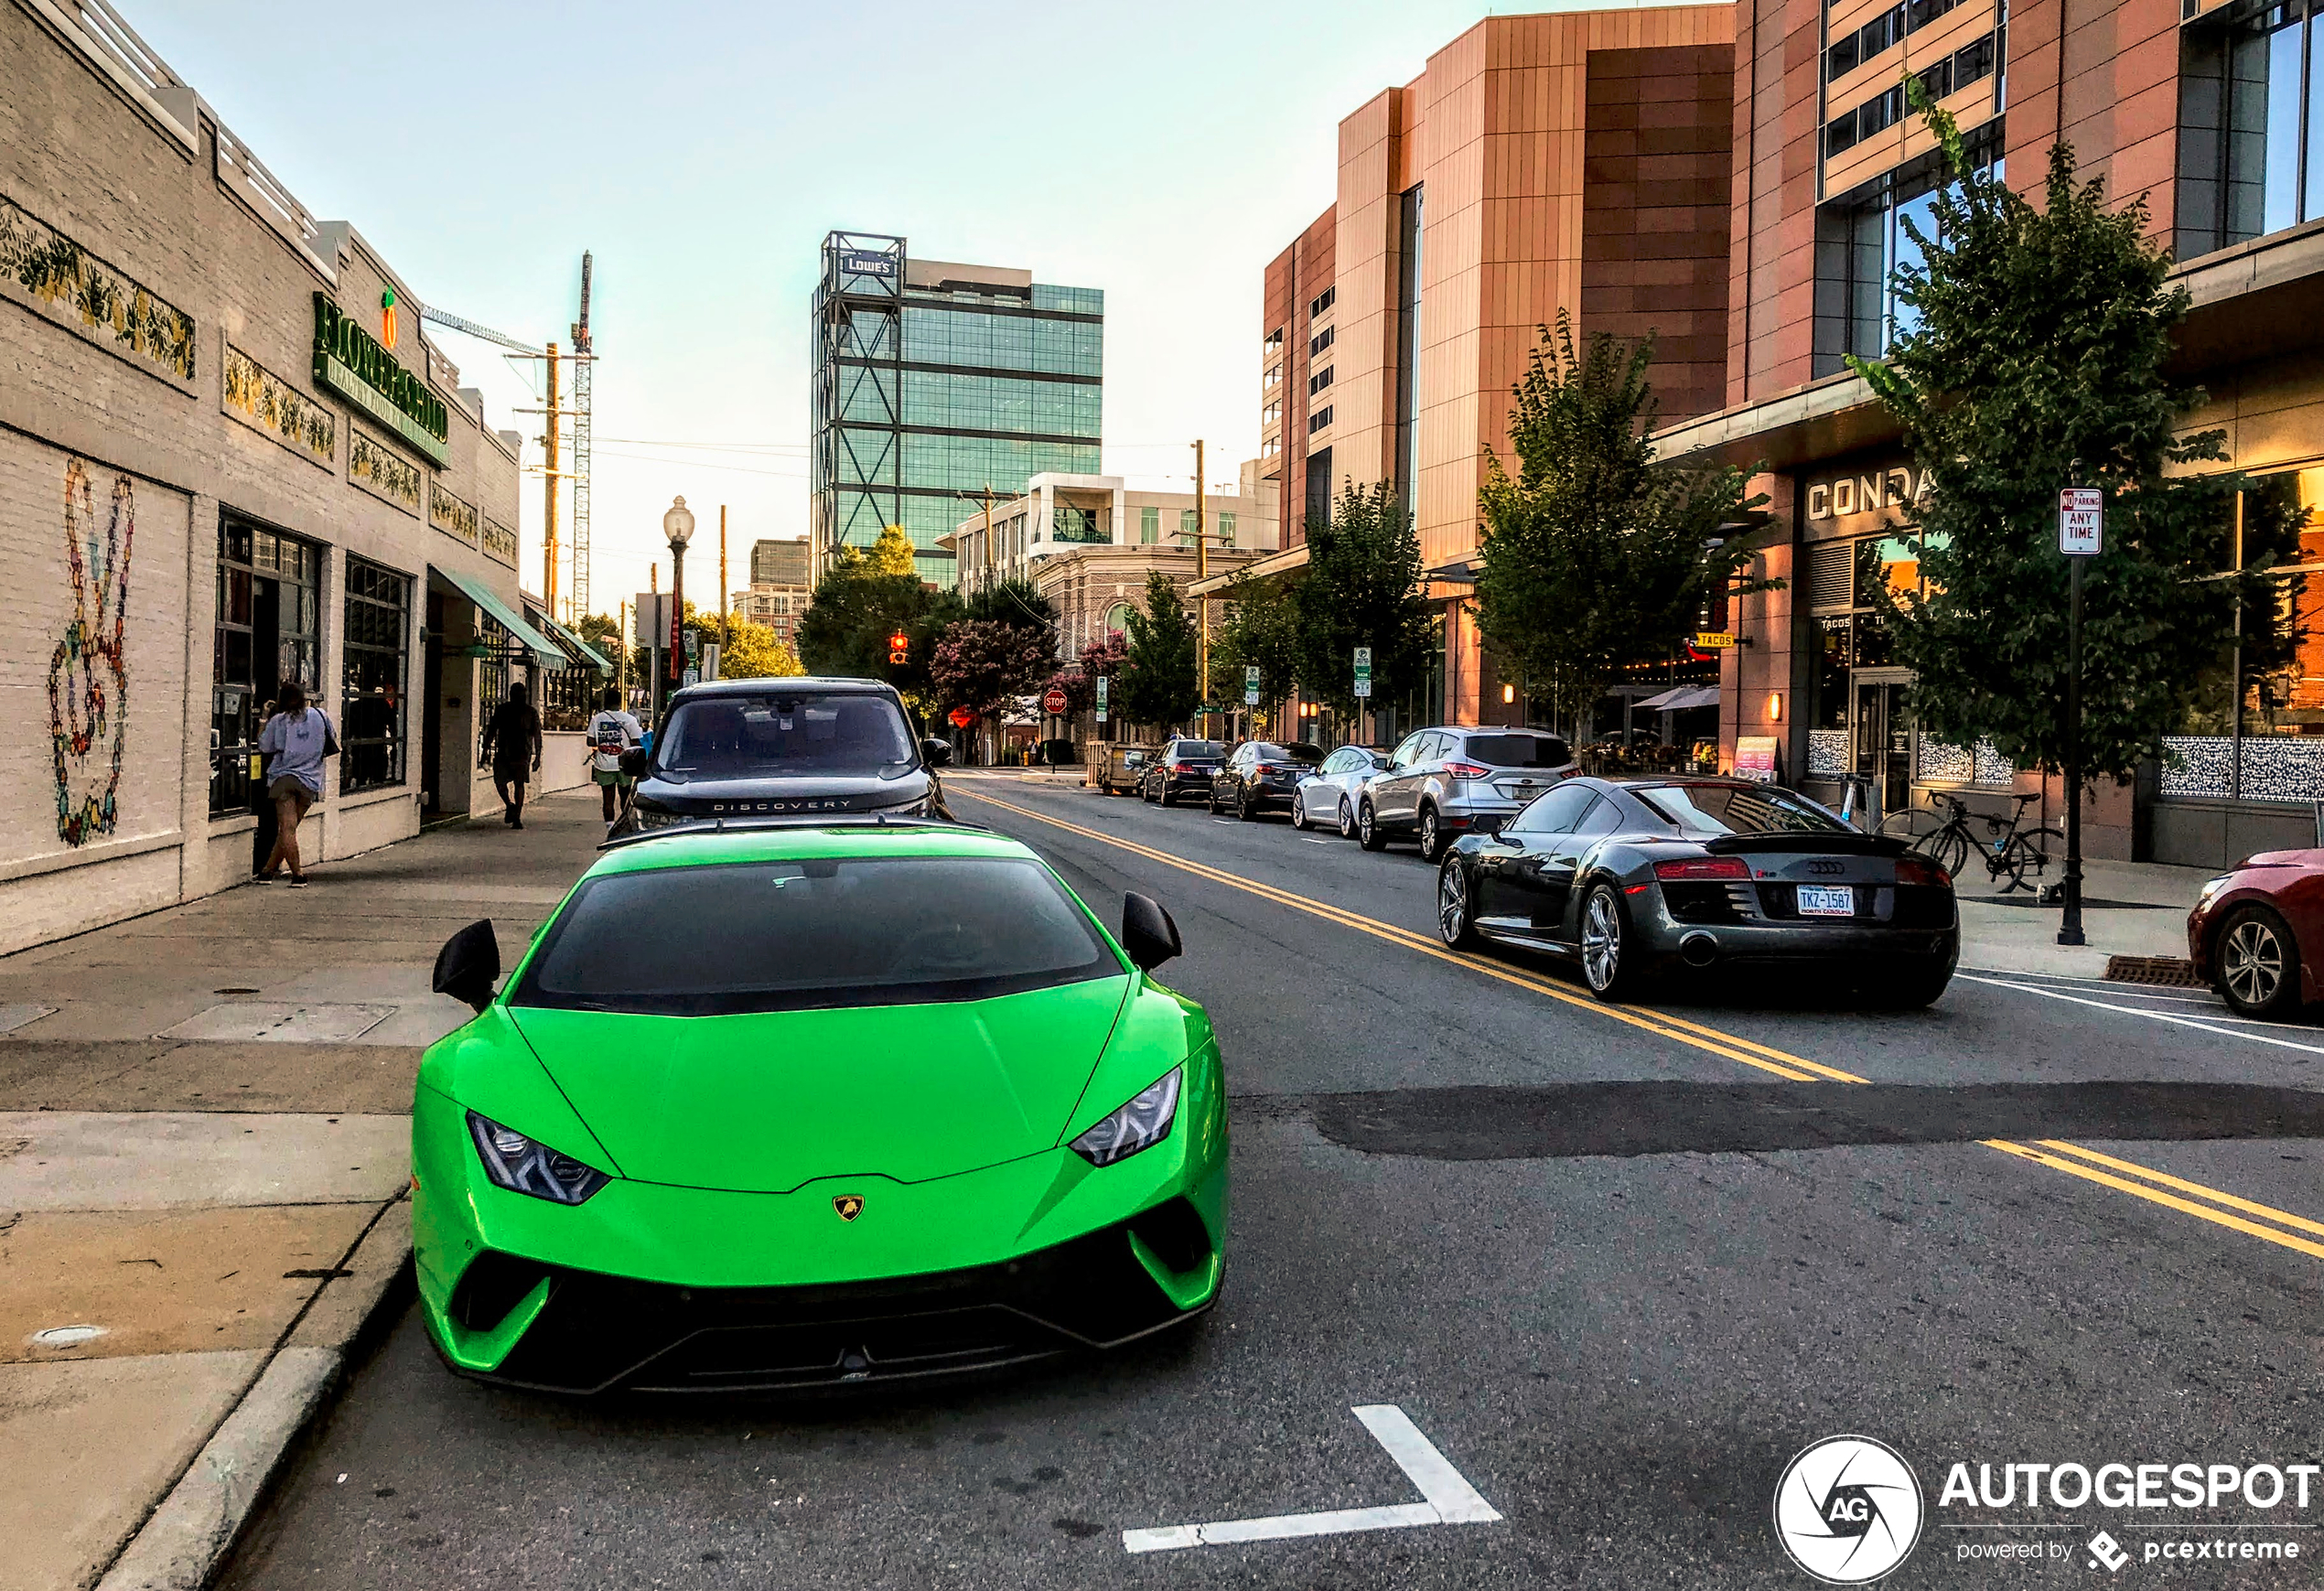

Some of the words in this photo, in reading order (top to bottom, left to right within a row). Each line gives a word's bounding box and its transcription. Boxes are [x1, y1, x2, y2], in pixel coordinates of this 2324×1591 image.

[848, 258, 890, 274] LOWE'S
[316, 292, 400, 408] FLOWER
[403, 369, 447, 445] CHILD
[1809, 465, 1941, 521] CONDA
[2062, 495, 2073, 507] NO
[2074, 497, 2099, 505] PARKING
[2070, 512, 2092, 524] ANY
[2069, 527, 2093, 539] TIME
[1821, 618, 1851, 629] TACOS
[1702, 635, 1731, 645] TACOS
[1046, 697, 1065, 706] STOP
[714, 801, 850, 811] DISCOVERY
[1801, 892, 1850, 908] TKZ-1587
